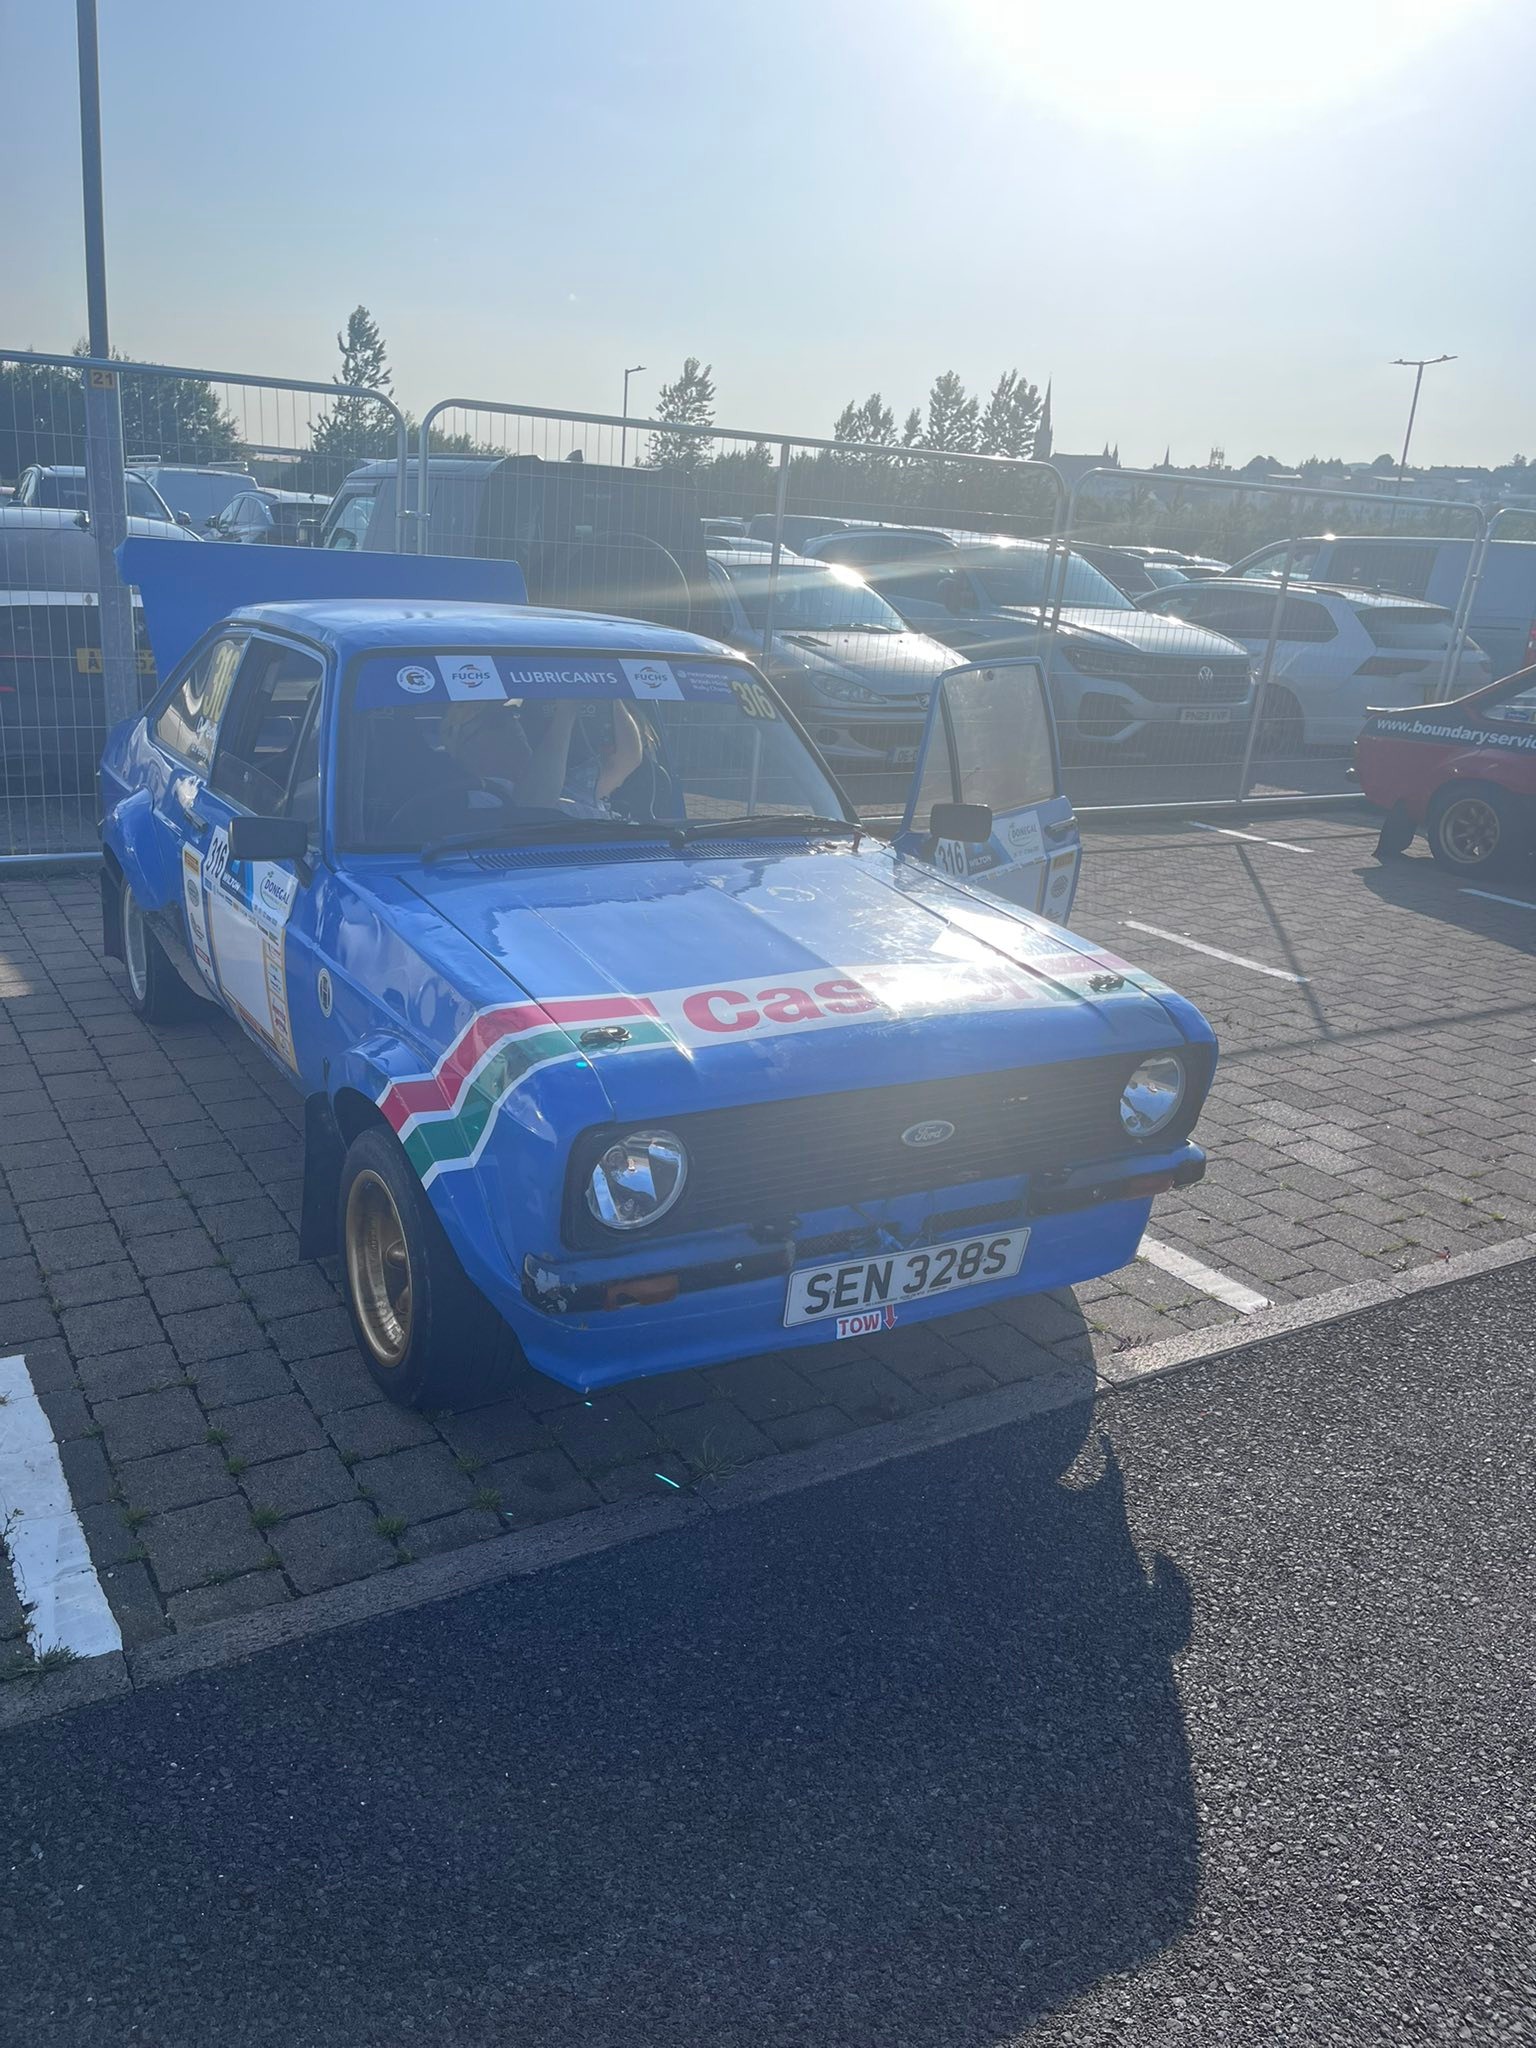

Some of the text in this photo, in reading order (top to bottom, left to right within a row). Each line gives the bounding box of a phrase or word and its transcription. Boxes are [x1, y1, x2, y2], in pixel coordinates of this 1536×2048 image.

[93, 371, 113, 386] 21
[451, 672, 491, 681] FUCHS
[509, 671, 618, 684] LUBRICANTS
[634, 673, 669, 682] FUCHS
[731, 680, 777, 720] 316
[1011, 823, 1038, 838] DONEGAL
[205, 837, 229, 879] 316
[938, 841, 965, 876] 316
[968, 855, 992, 868] WILTON
[264, 879, 291, 905] DONEGAL
[683, 964, 1035, 1032] Casol
[914, 1125, 944, 1141] Ford
[804, 1260, 894, 1315] SEN
[902, 1238, 1012, 1294] 328S
[838, 1313, 880, 1337] TOW
